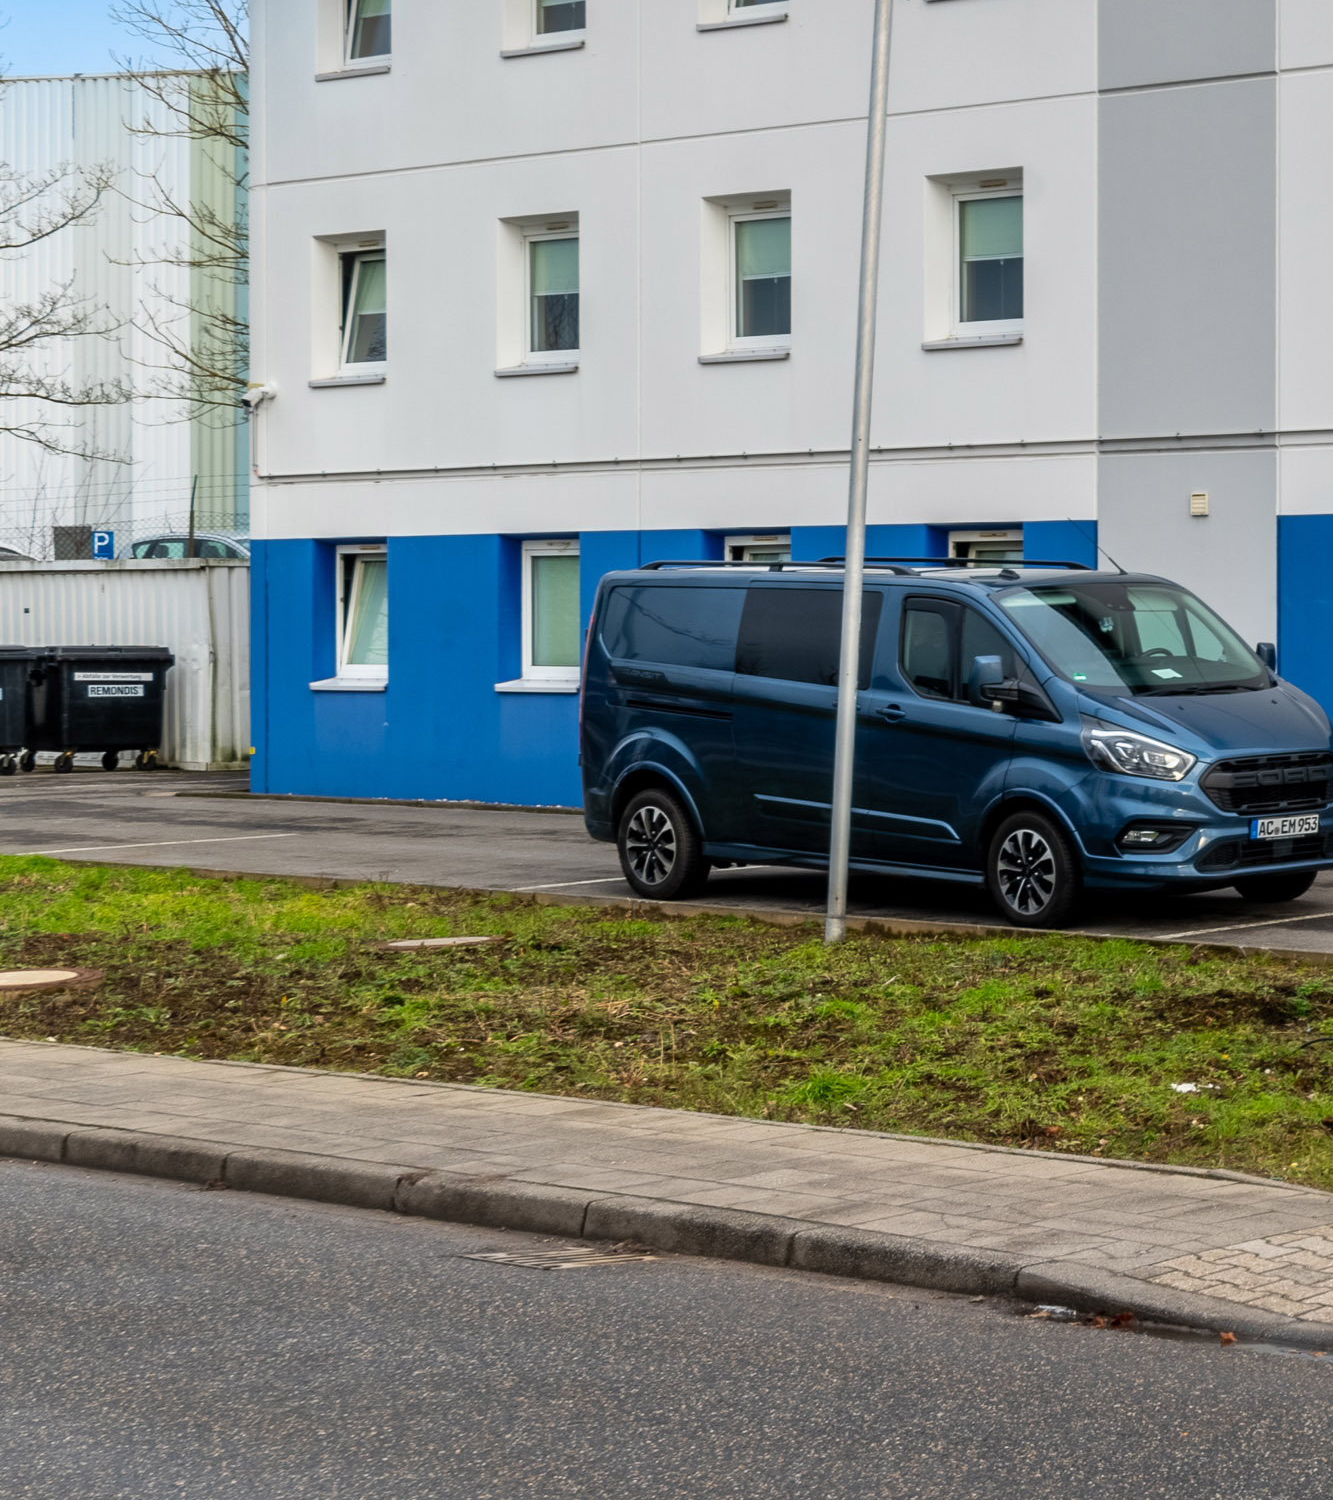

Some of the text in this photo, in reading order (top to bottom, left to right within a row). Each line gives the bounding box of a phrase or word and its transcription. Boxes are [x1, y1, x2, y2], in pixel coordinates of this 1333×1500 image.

[94, 532, 110, 554] P
[89, 685, 139, 696] REMONDIS
[1258, 820, 1275, 836] AC
